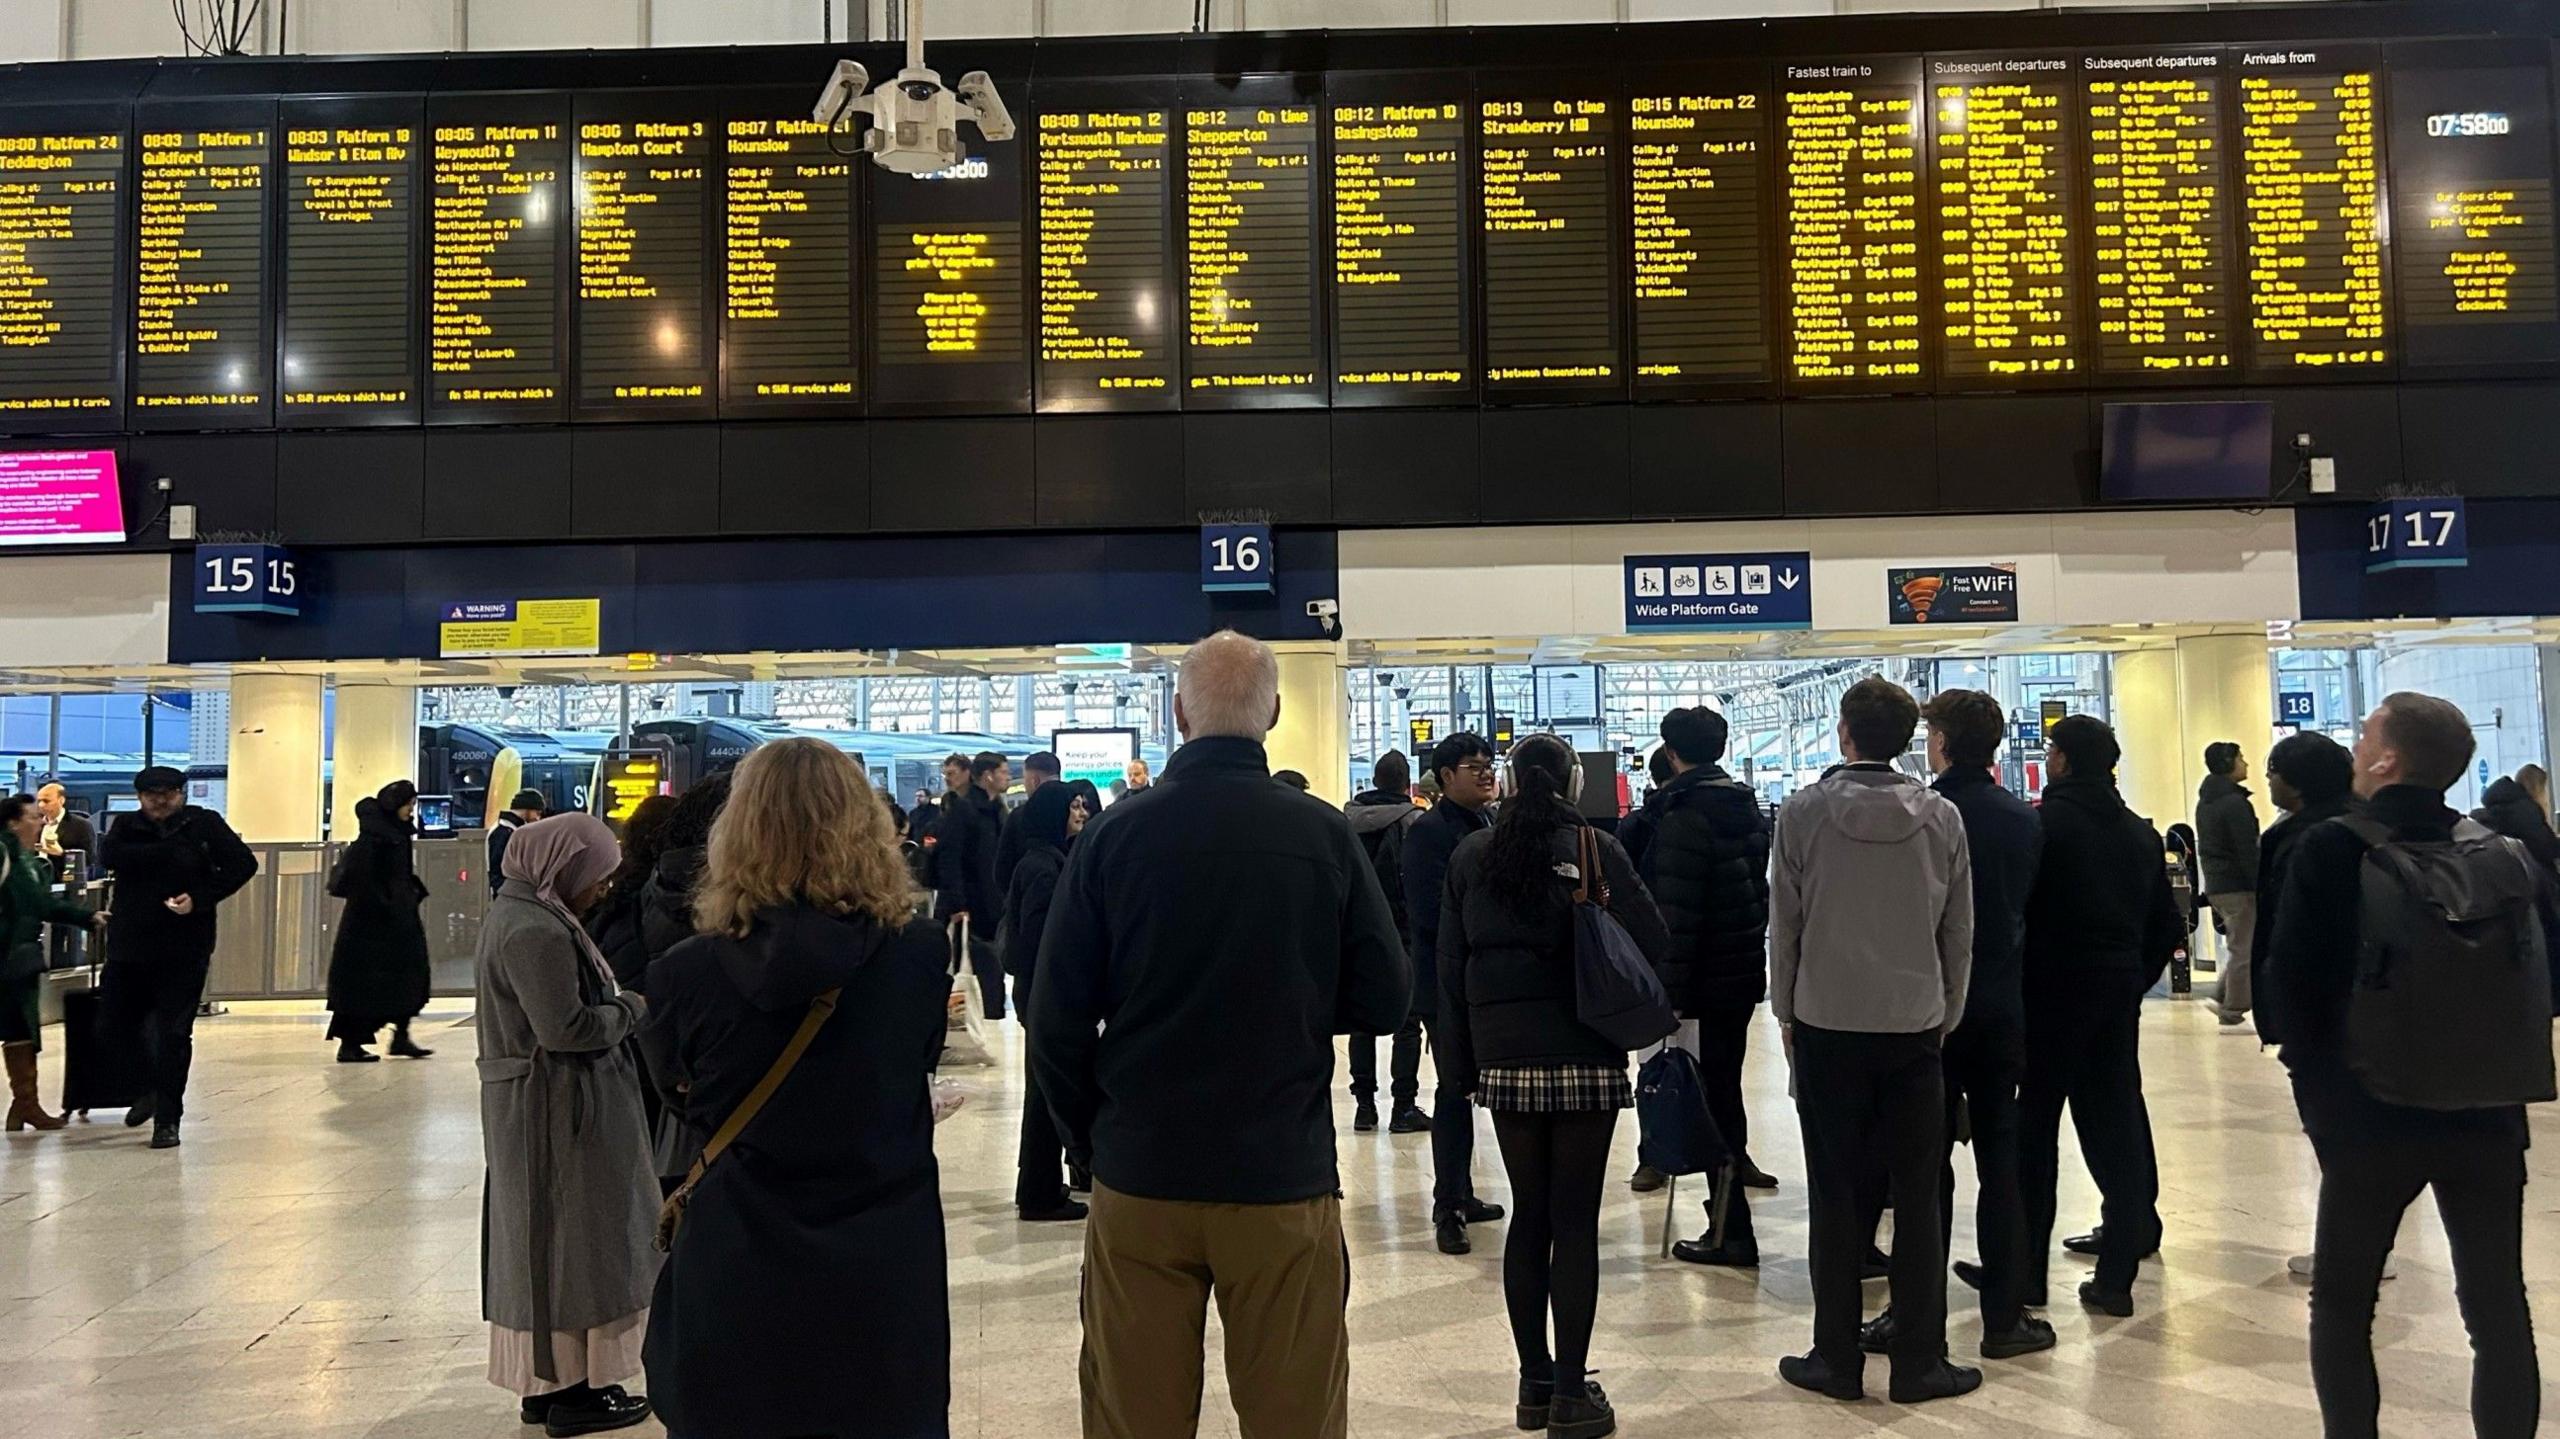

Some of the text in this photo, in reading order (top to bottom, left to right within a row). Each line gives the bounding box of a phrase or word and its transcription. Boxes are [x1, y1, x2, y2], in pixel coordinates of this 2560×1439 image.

[2085, 54, 2217, 70] Subsequent departures
[2243, 52, 2316, 65] Arrivals from
[1788, 65, 1872, 78] Fastest train to
[1935, 59, 2067, 75] Subsequent departures
[1554, 101, 1571, 114] On
[1577, 101, 1605, 113] time
[1679, 97, 1733, 110] Platform
[1739, 95, 1755, 108] 22
[1088, 114, 1142, 127] Platform
[1148, 113, 1161, 126] 12
[1187, 109, 1308, 125] 08:12 On time
[1335, 107, 1374, 122] 08:12
[1383, 106, 1436, 120] Platform
[636, 124, 689, 137] Platform
[693, 123, 702, 136] 3
[728, 121, 767, 135] 08:07
[1483, 118, 1589, 134] Strawberry Hill
[1632, 116, 1694, 130] Hounslow
[143, 132, 263, 147] 08:03 Platform 1
[289, 129, 409, 144] 08:03 Platform 18
[436, 126, 556, 141] 08:05 Platform 11
[1040, 131, 1167, 146] Portsmouth Harbour
[1188, 129, 1268, 144] Shepperton
[1335, 125, 1418, 140] Basingstoke
[43, 137, 96, 150] Platform
[99, 136, 117, 149] 24
[581, 141, 683, 157] Hampton Court
[728, 140, 789, 153] Hounslow
[143, 151, 203, 165] Guildford
[288, 149, 335, 162] Windsor
[340, 148, 348, 161] &
[353, 148, 382, 160] Eton
[436, 144, 514, 160] Weymouth &
[0, 155, 72, 169] Teddington
[0, 219, 30, 229] lapham
[2368, 514, 2390, 552] 17
[2404, 511, 2455, 546] 17
[1211, 536, 1260, 572] 16
[206, 558, 254, 592] 15
[268, 560, 295, 595] 15
[1953, 576, 1970, 584] Fast
[1953, 584, 1971, 592] Free
[1972, 576, 2013, 591] WiFi
[467, 604, 507, 612] WARNING
[1635, 602, 1759, 616] Wide Platform Gate
[2288, 697, 2310, 714] 18
[452, 751, 487, 760] 450060
[1065, 751, 1088, 760] Keep
